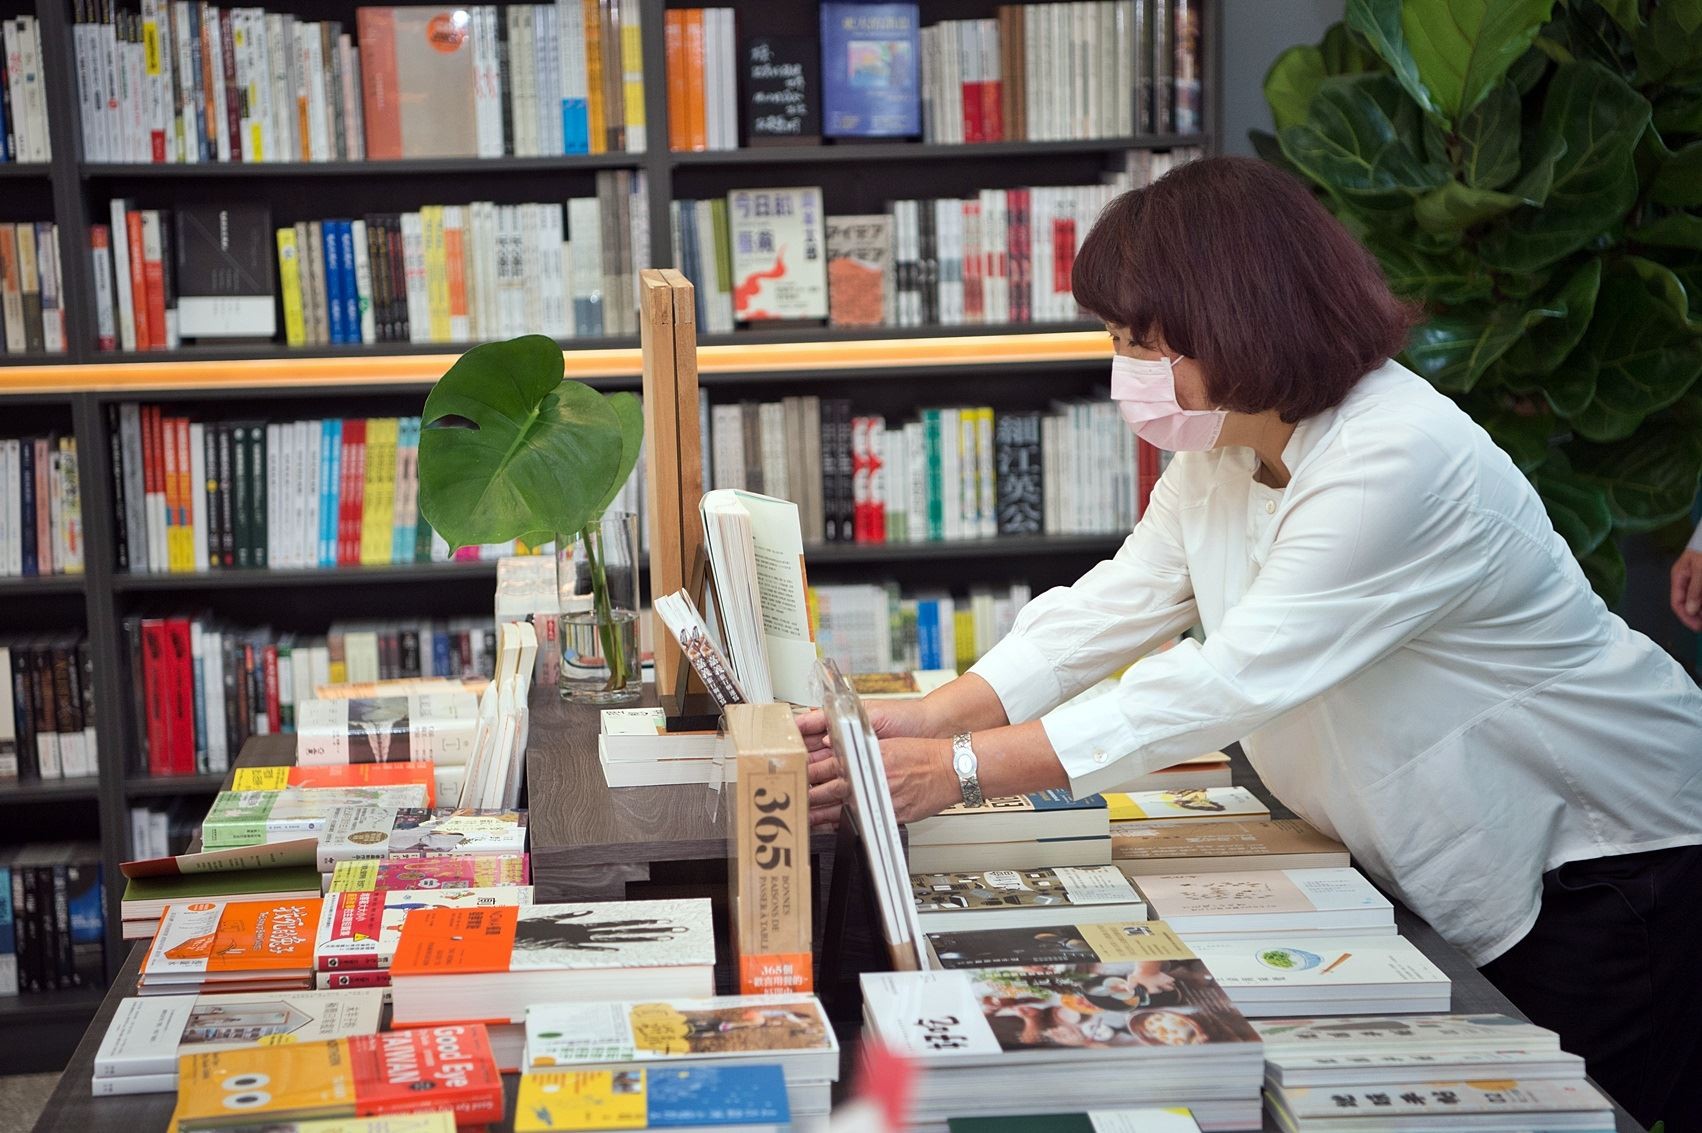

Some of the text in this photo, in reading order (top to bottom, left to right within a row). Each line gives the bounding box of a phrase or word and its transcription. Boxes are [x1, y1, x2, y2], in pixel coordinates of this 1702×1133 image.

[754, 787, 793, 871] 365
[759, 875, 768, 913] PASSER
[770, 875, 780, 932] RAISONS DE
[781, 875, 790, 916] BONNES
[380, 1030, 421, 1084] TAIWAN
[432, 1025, 474, 1088] Good Eye
[914, 1015, 969, 1051] 好吃
